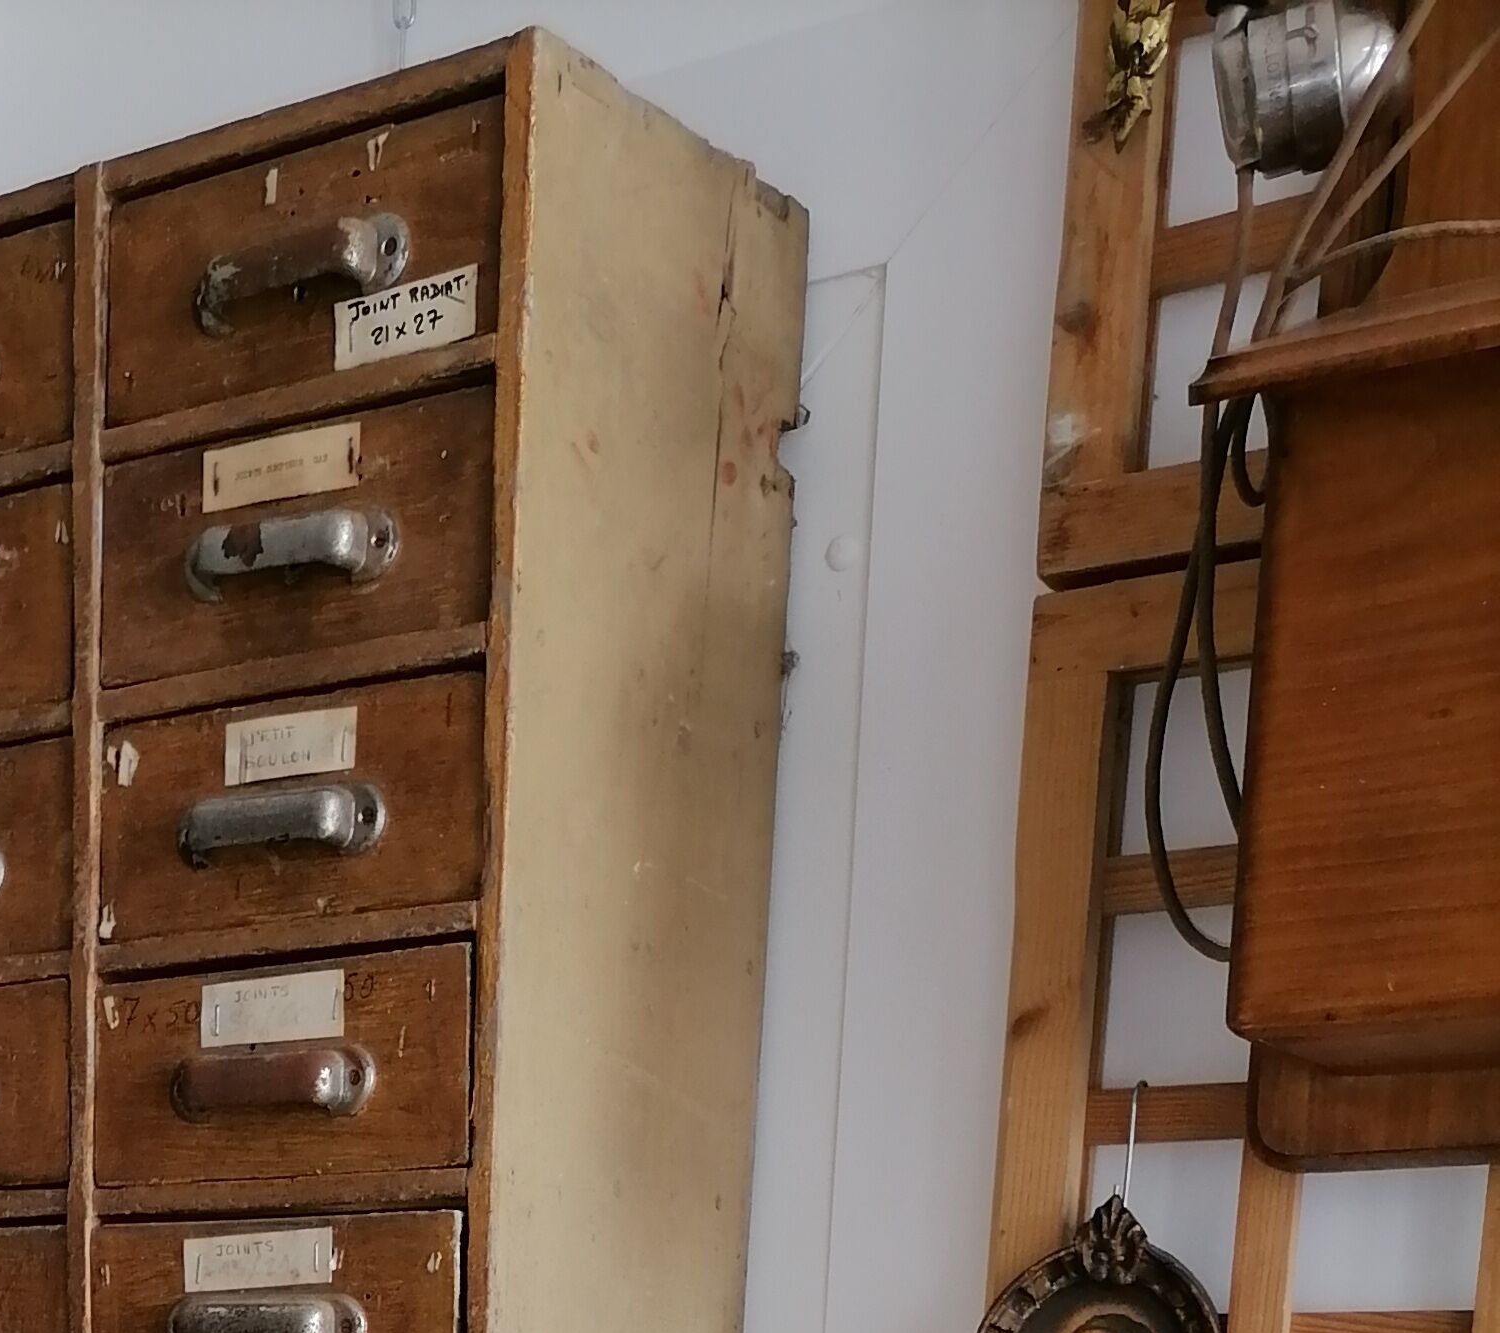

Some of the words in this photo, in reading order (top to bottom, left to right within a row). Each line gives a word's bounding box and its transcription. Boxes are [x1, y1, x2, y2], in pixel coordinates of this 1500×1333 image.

[347, 293, 402, 323] JOINT
[370, 322, 389, 345] 21
[413, 308, 444, 335] 27
[215, 1241, 274, 1257] JOINTS
